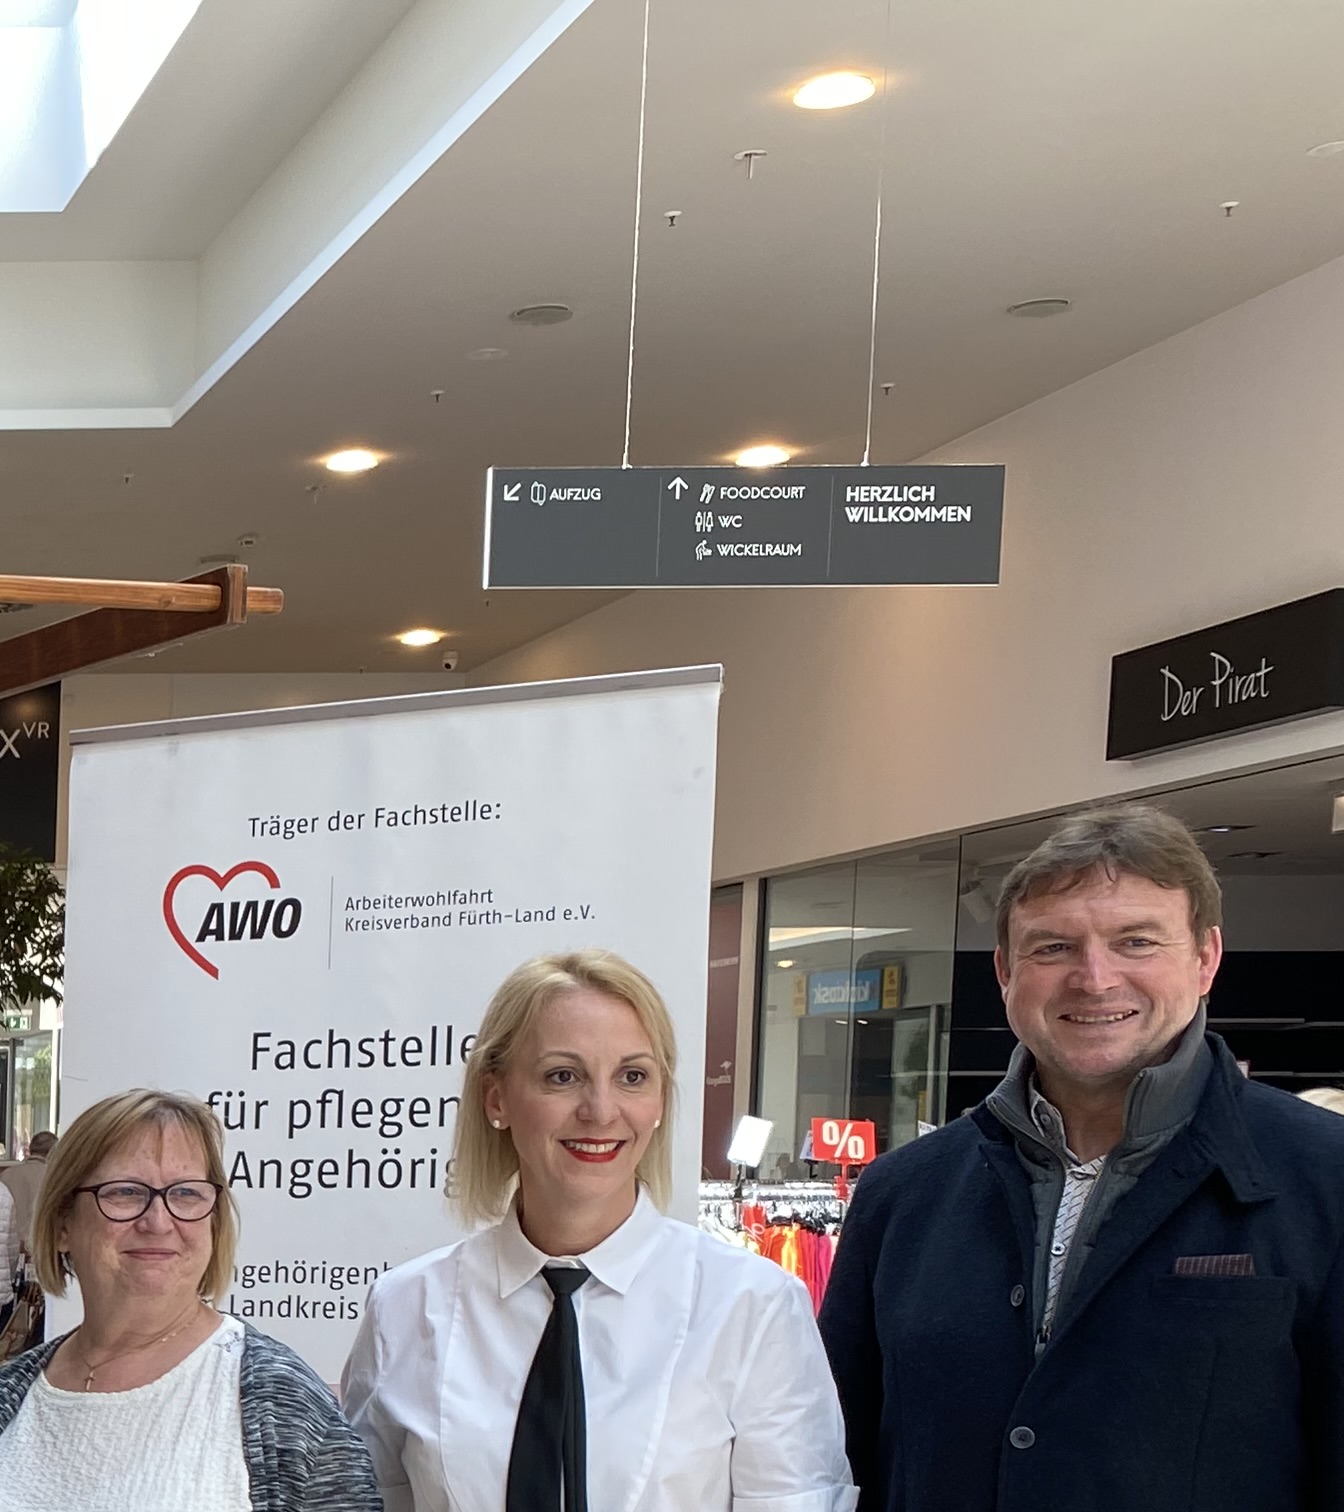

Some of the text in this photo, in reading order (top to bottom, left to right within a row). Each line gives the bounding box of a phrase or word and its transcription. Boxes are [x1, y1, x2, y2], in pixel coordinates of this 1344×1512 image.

[549, 487, 602, 501] AUFZUG
[720, 485, 806, 501] FOODCOURT
[845, 485, 936, 503] HERZLICH
[718, 514, 743, 529] WC
[844, 505, 972, 524] WILLKOMMEN
[716, 543, 802, 558] WICKELRAUM
[1160, 652, 1275, 722] Der Pirat
[22, 721, 50, 740] VR
[248, 799, 503, 840] Träger der Fachstelle:
[344, 888, 494, 913] Arbeiterwohlfahrt
[194, 897, 303, 943] AWO
[344, 911, 452, 933] Kreisverband
[562, 904, 597, 922] e.V.
[229, 1293, 359, 1320] Landkreis
